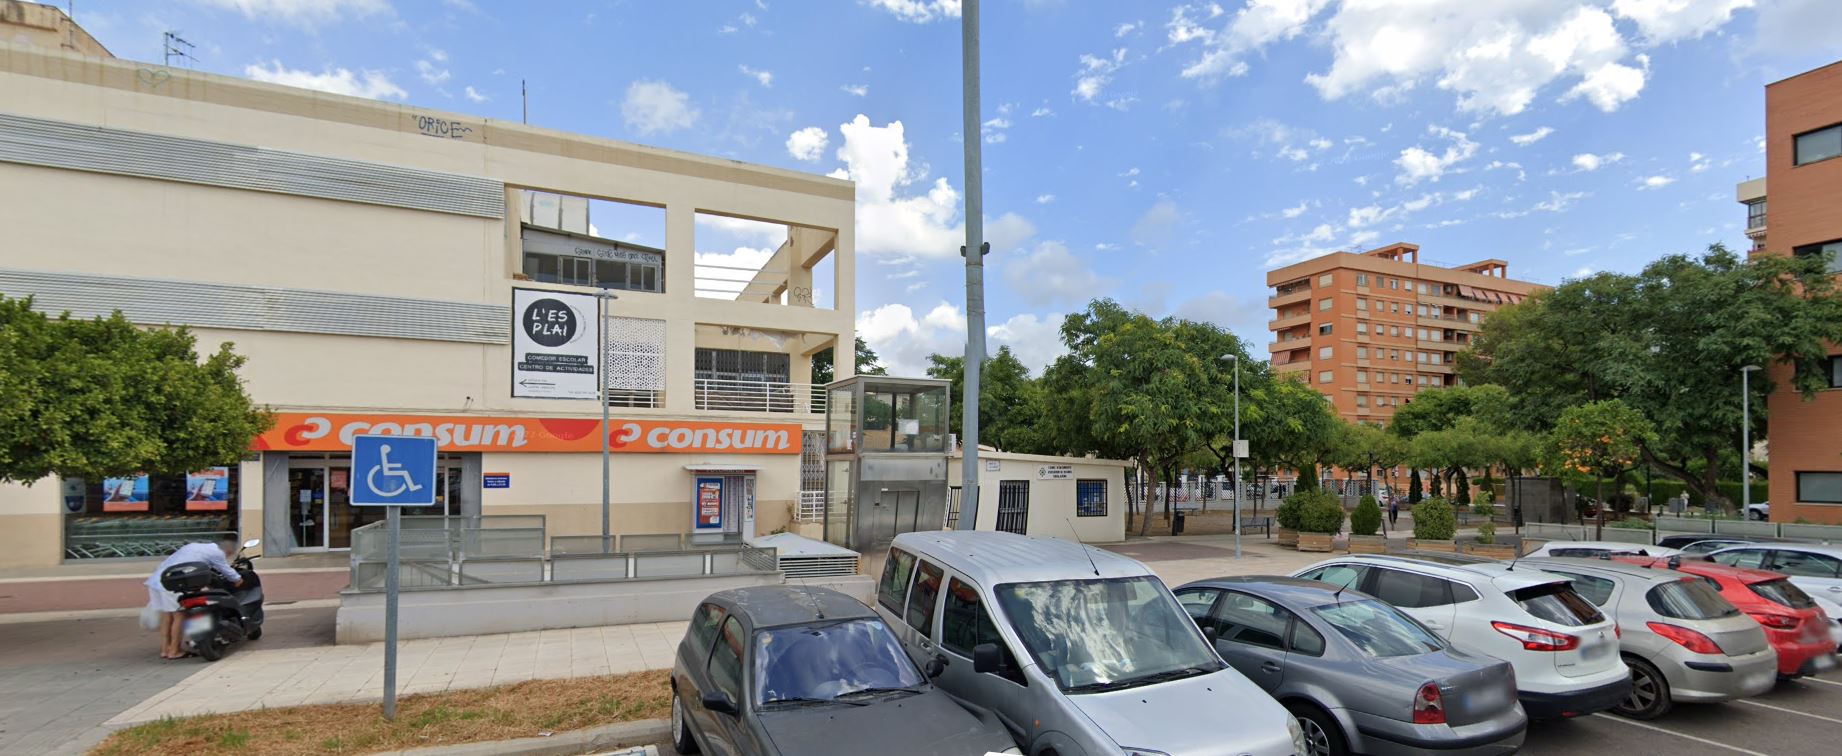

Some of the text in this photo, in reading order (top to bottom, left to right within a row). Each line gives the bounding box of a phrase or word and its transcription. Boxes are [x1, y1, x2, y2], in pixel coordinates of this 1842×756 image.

[532, 308, 568, 322] L'ES
[532, 322, 567, 336] PLAI
[647, 427, 791, 450] consum
